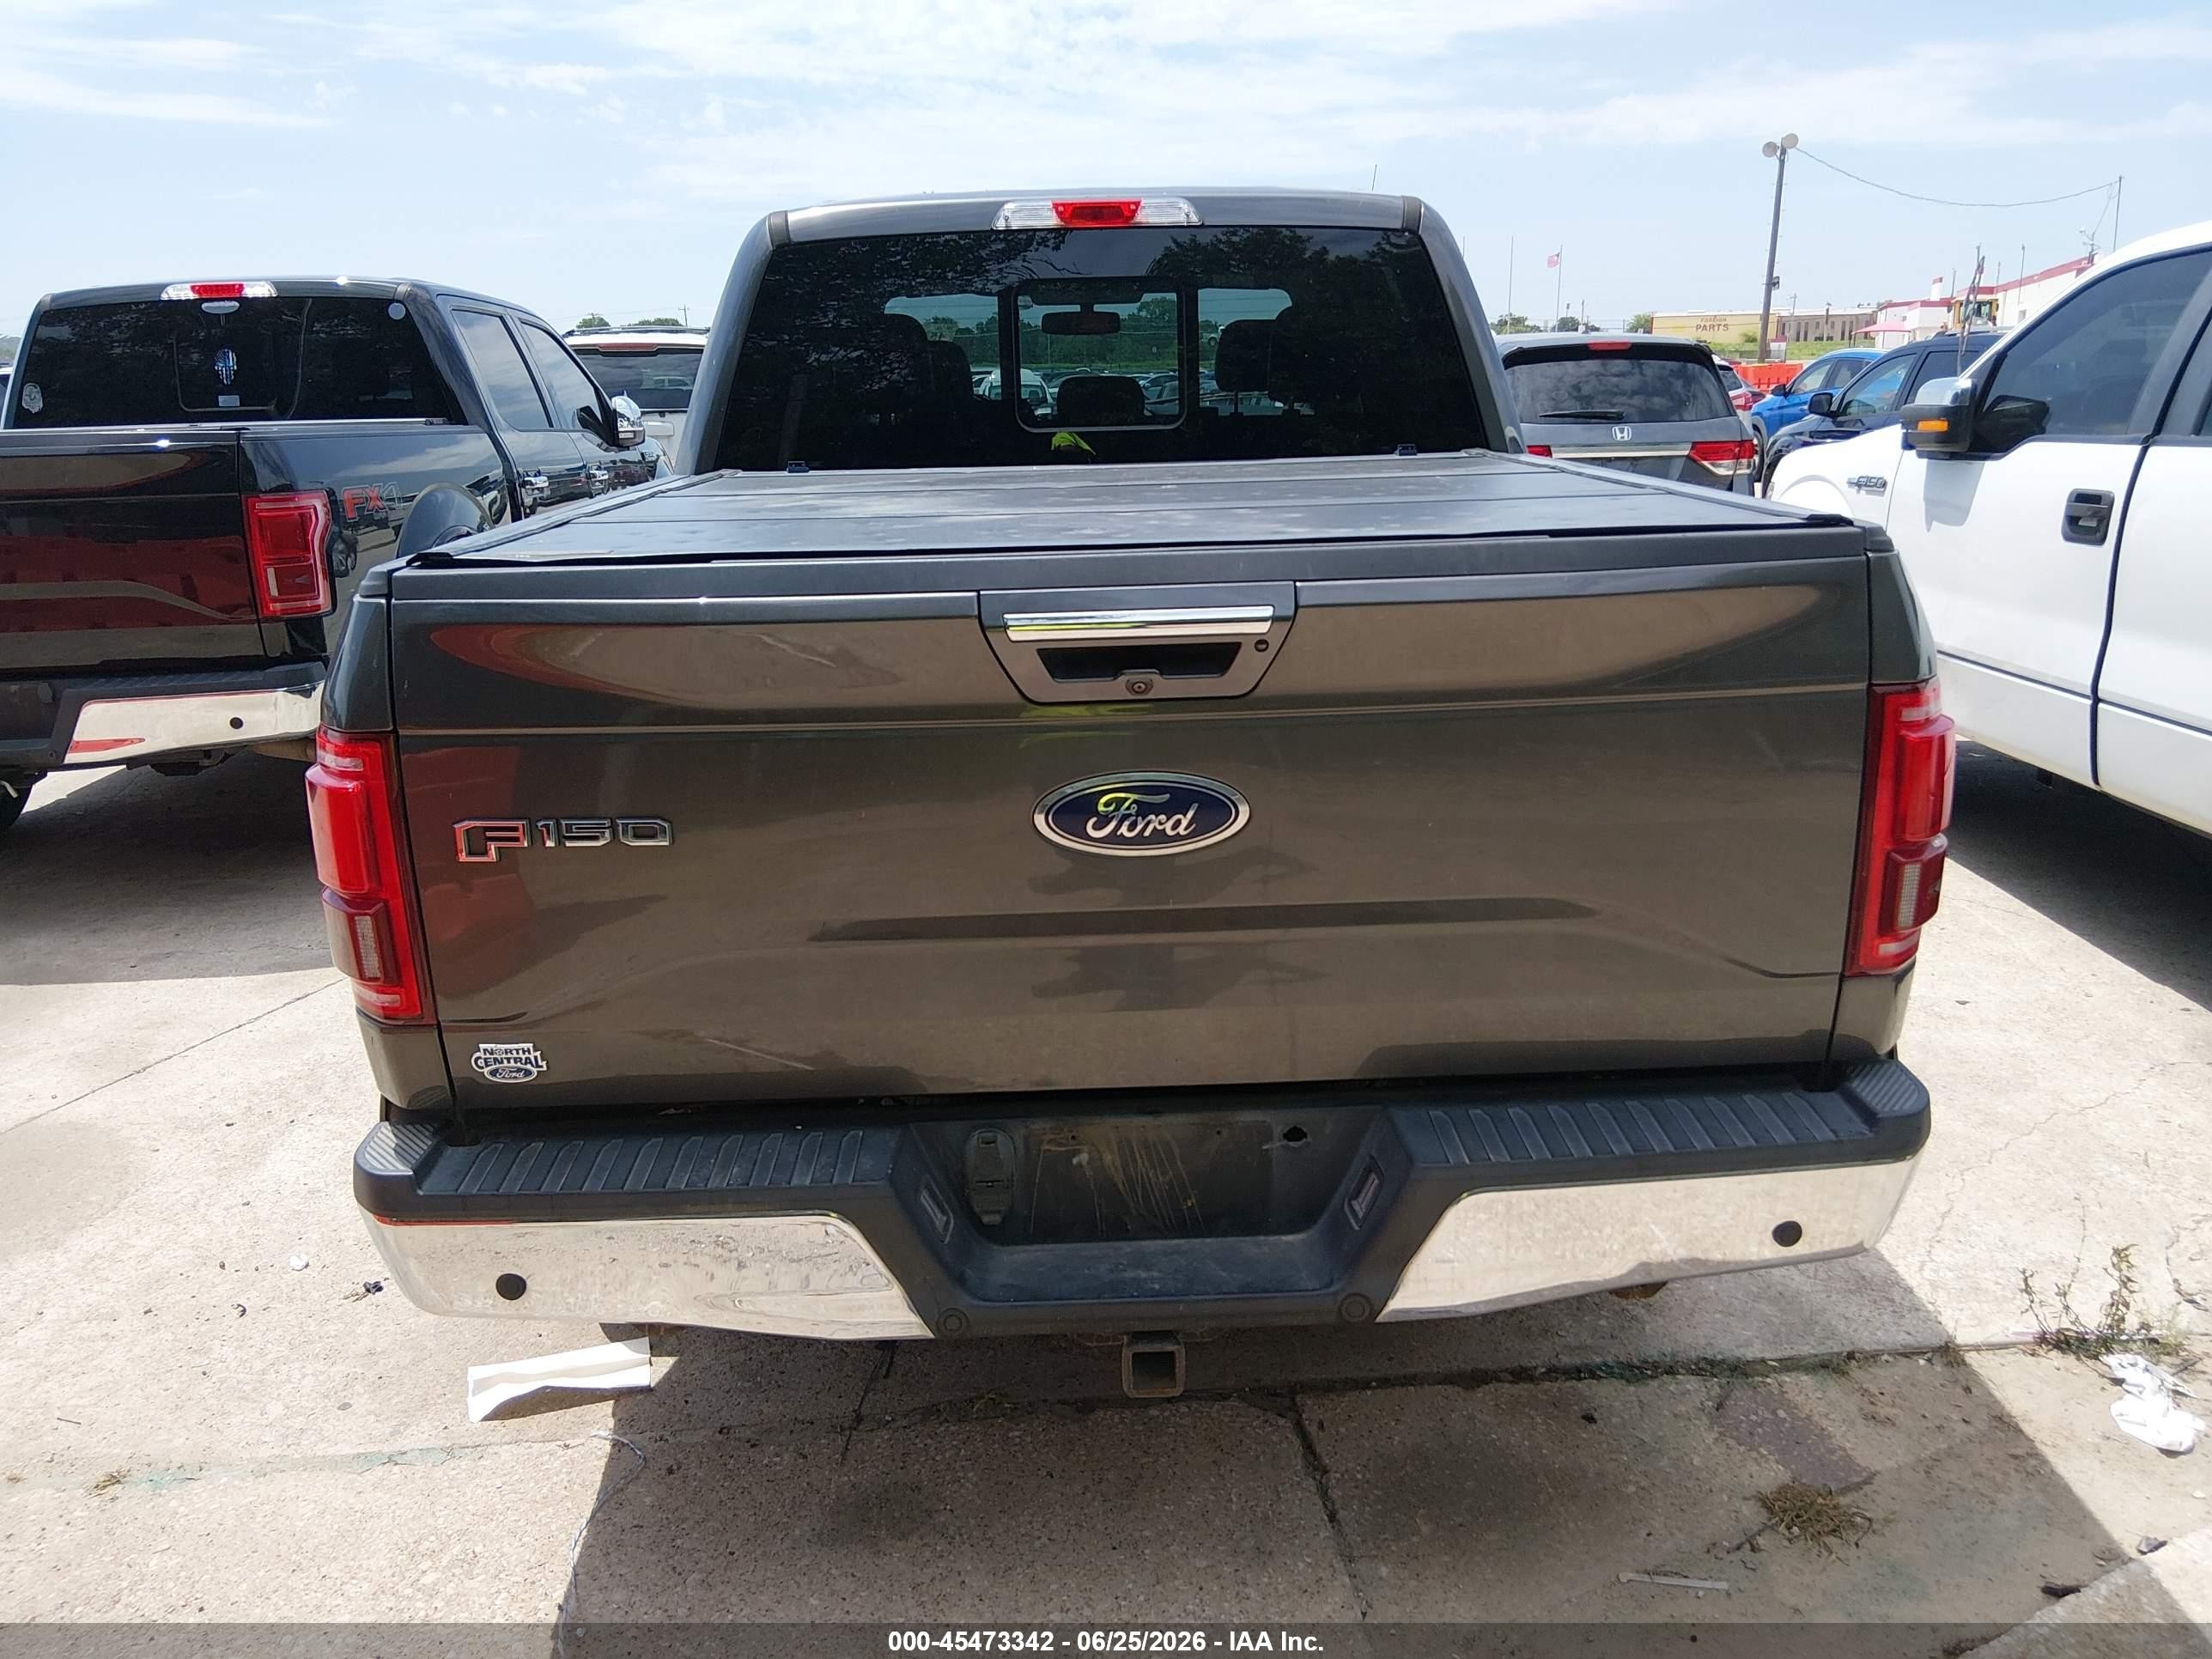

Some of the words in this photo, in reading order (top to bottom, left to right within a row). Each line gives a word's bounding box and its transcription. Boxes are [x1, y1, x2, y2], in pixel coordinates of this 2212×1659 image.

[1696, 323, 1729, 331] PARTS
[341, 481, 404, 522] FX4
[1085, 792, 1200, 839] Ford
[483, 1048, 532, 1056] NORTH
[473, 1055, 544, 1071] CENTRAL
[495, 1067, 526, 1079] Ford
